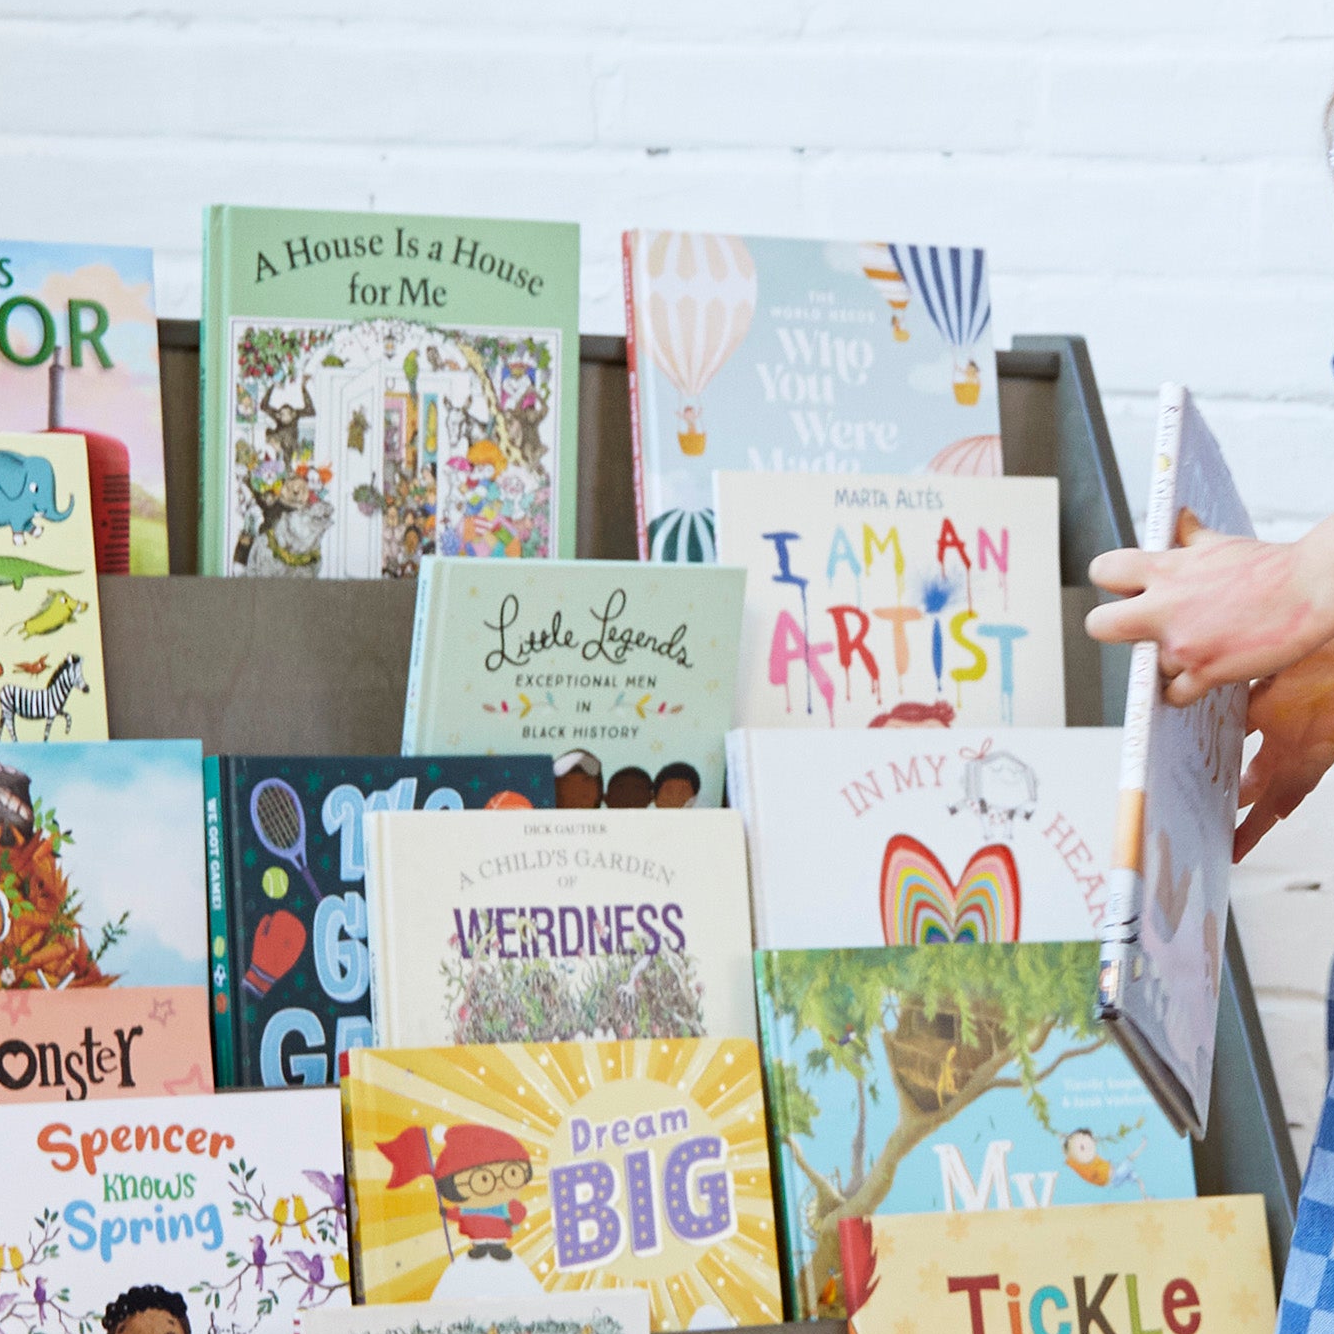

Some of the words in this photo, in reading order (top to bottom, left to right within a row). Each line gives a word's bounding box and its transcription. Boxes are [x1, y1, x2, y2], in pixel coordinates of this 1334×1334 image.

[254, 251, 279, 283] A
[284, 229, 384, 271] House
[395, 227, 419, 258] Is
[427, 241, 443, 261] a
[450, 237, 545, 297] House
[348, 273, 392, 307] for
[398, 277, 448, 307] Me
[776, 327, 874, 385] Who
[756, 362, 835, 405] You
[788, 410, 898, 453] Were
[835, 488, 888, 510] MARTA
[762, 531, 809, 585] I
[826, 523, 906, 583] AM
[936, 517, 1009, 573] AN
[484, 594, 579, 672] Little
[582, 588, 693, 668] Legends
[515, 674, 618, 688] EXCEPTIONAL
[625, 674, 657, 688] MEN
[576, 701, 591, 713] IN
[522, 726, 565, 739] BLACK
[573, 726, 639, 739] HISTORY
[840, 774, 885, 818] IN
[893, 754, 948, 792] MY
[524, 824, 551, 836] DICK
[555, 823, 607, 835] GAUTIER
[459, 871, 475, 891] A
[478, 848, 568, 880] CHILD'S
[575, 849, 676, 887] GARDEN
[558, 876, 576, 889] OF
[454, 903, 686, 960] WEIRDNESS
[37, 1122, 235, 1175] Spencer
[571, 1108, 690, 1157] Dream
[549, 1134, 735, 1269] BIG
[63, 1200, 224, 1263] Spring
